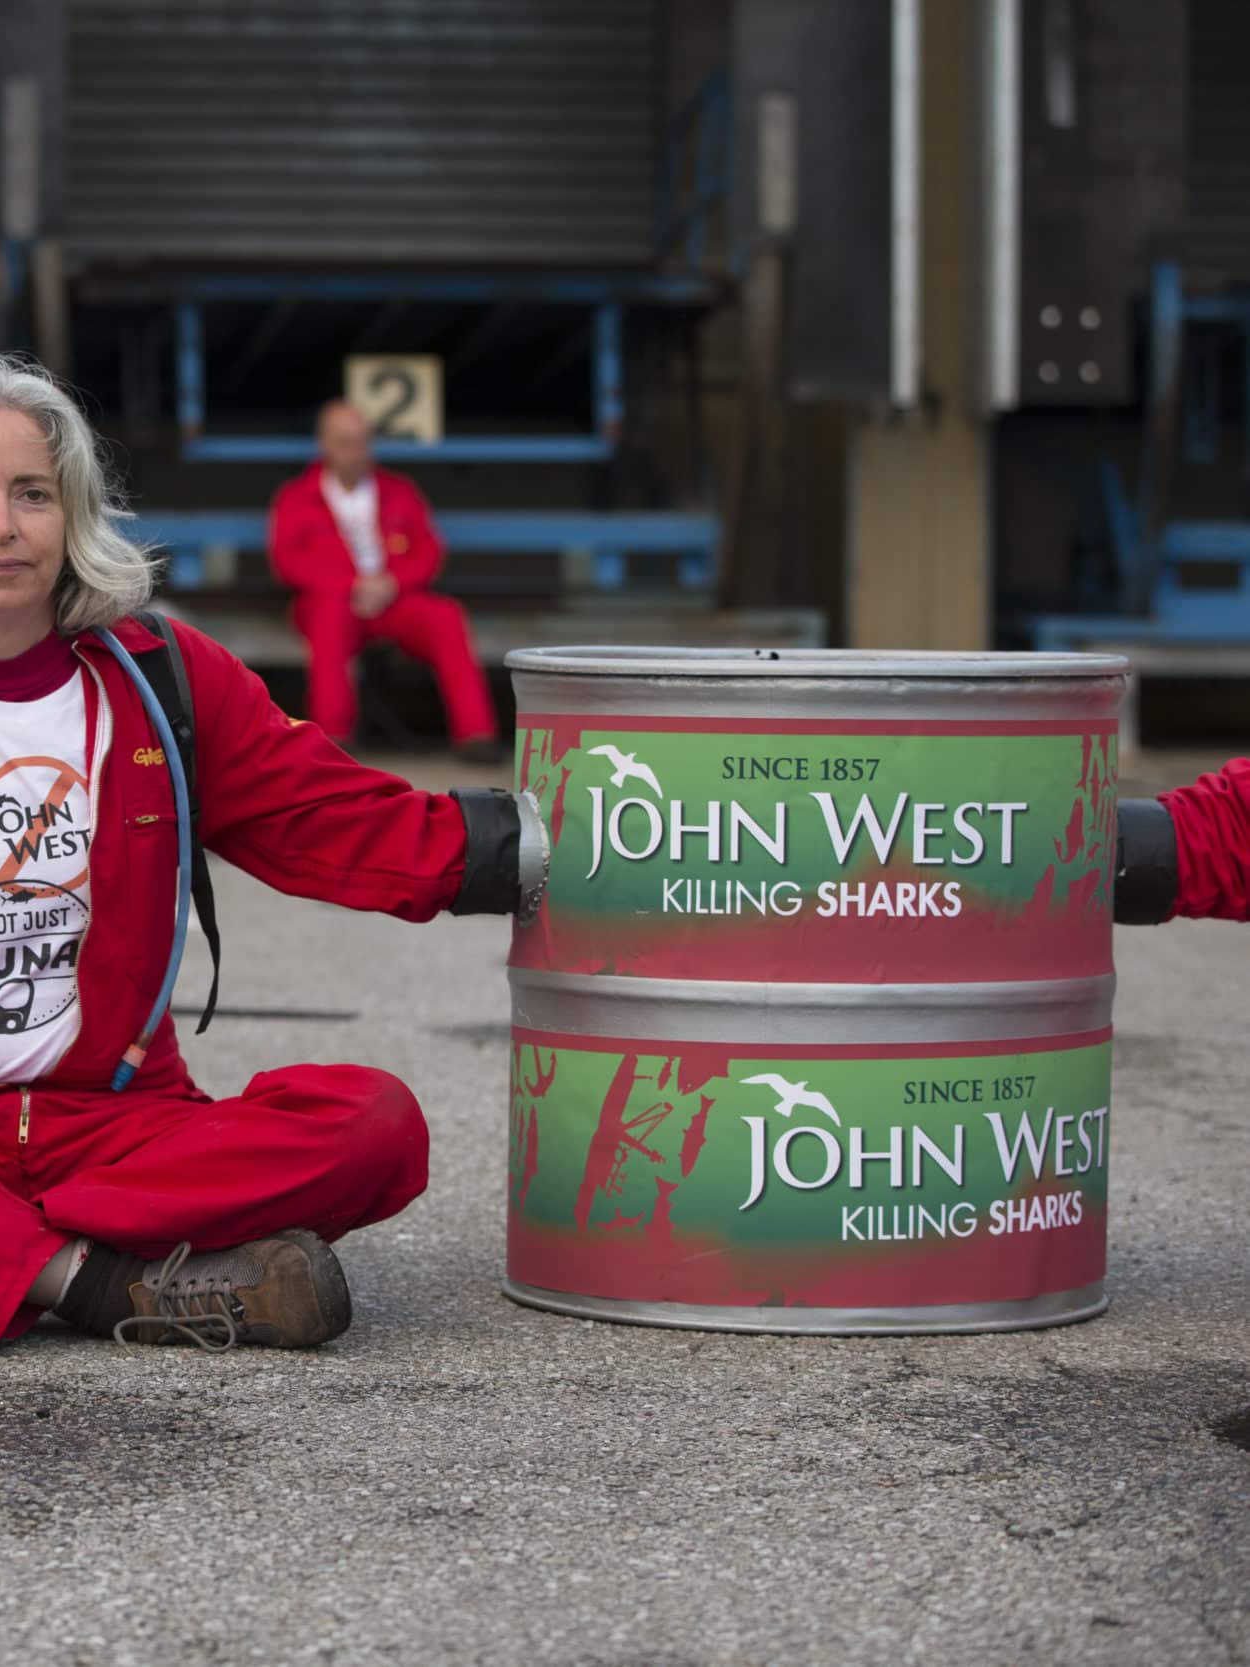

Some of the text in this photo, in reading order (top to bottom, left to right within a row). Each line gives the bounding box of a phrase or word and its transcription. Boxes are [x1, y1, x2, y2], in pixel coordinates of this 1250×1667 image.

[367, 365, 418, 443] 2
[722, 756, 881, 783] SINCE 1857
[4, 829, 91, 864] WEST
[586, 787, 1028, 881] JOHN WEST
[662, 878, 963, 918] KILLING SHARKS
[23, 908, 71, 929] JUST
[903, 1076, 1036, 1105] SINCE 1857
[738, 1106, 1108, 1212] JOHN WEST
[842, 1190, 1083, 1242] KILLING SHARKS
